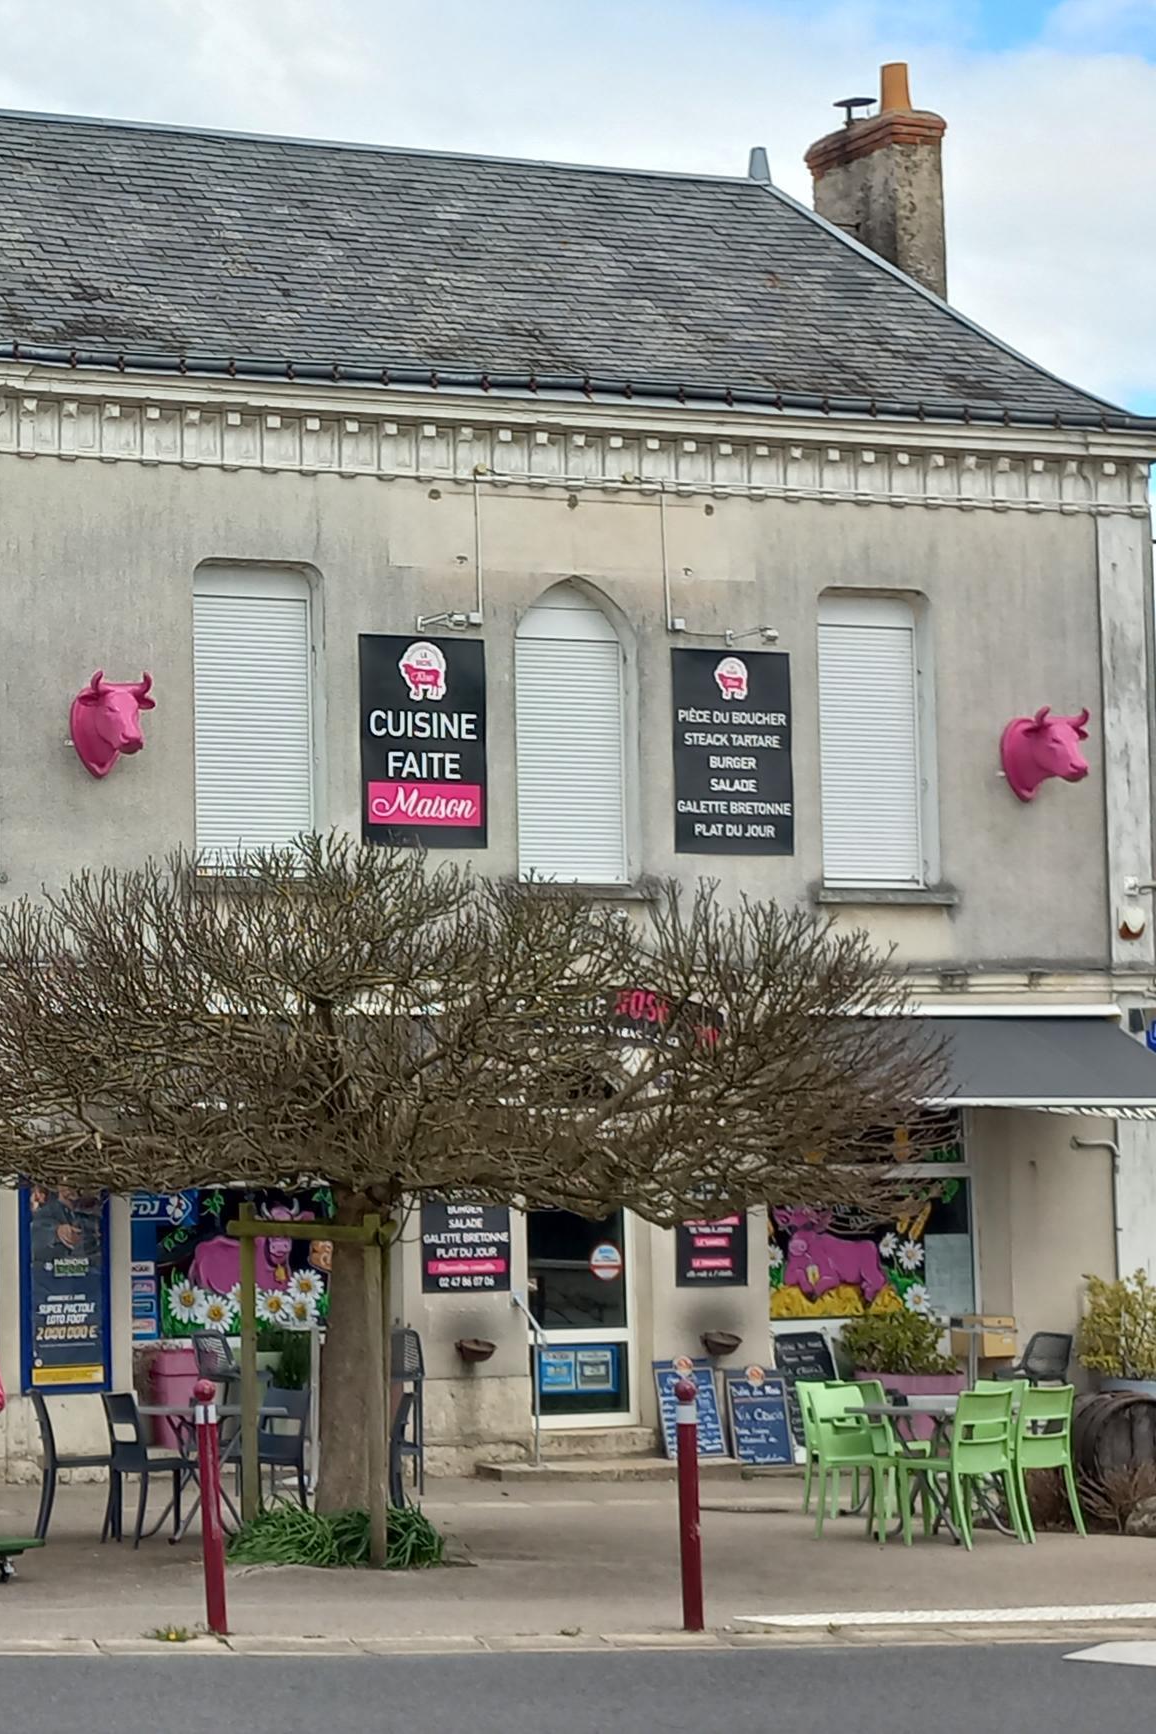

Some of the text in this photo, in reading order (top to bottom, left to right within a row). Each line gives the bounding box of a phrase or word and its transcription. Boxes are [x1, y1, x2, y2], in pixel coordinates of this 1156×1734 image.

[369, 709, 478, 740] CUISINE
[677, 707, 787, 727] PIÈCE DU BOUCHER
[684, 732, 782, 749] STEACK TARTARE
[387, 751, 462, 780] FAITE
[709, 755, 758, 770] BURGER
[710, 778, 758, 793] SALADE
[371, 785, 477, 819] Maison
[677, 800, 792, 817] GALETTE BRETONNE
[694, 823, 776, 838] PLAT DU JOUR
[130, 1200, 160, 1215] FDJ
[448, 1218, 483, 1229] SALADE
[424, 1231, 509, 1244] GALETTE BRETONNE
[436, 1246, 498, 1259] PLAT DU JOUR
